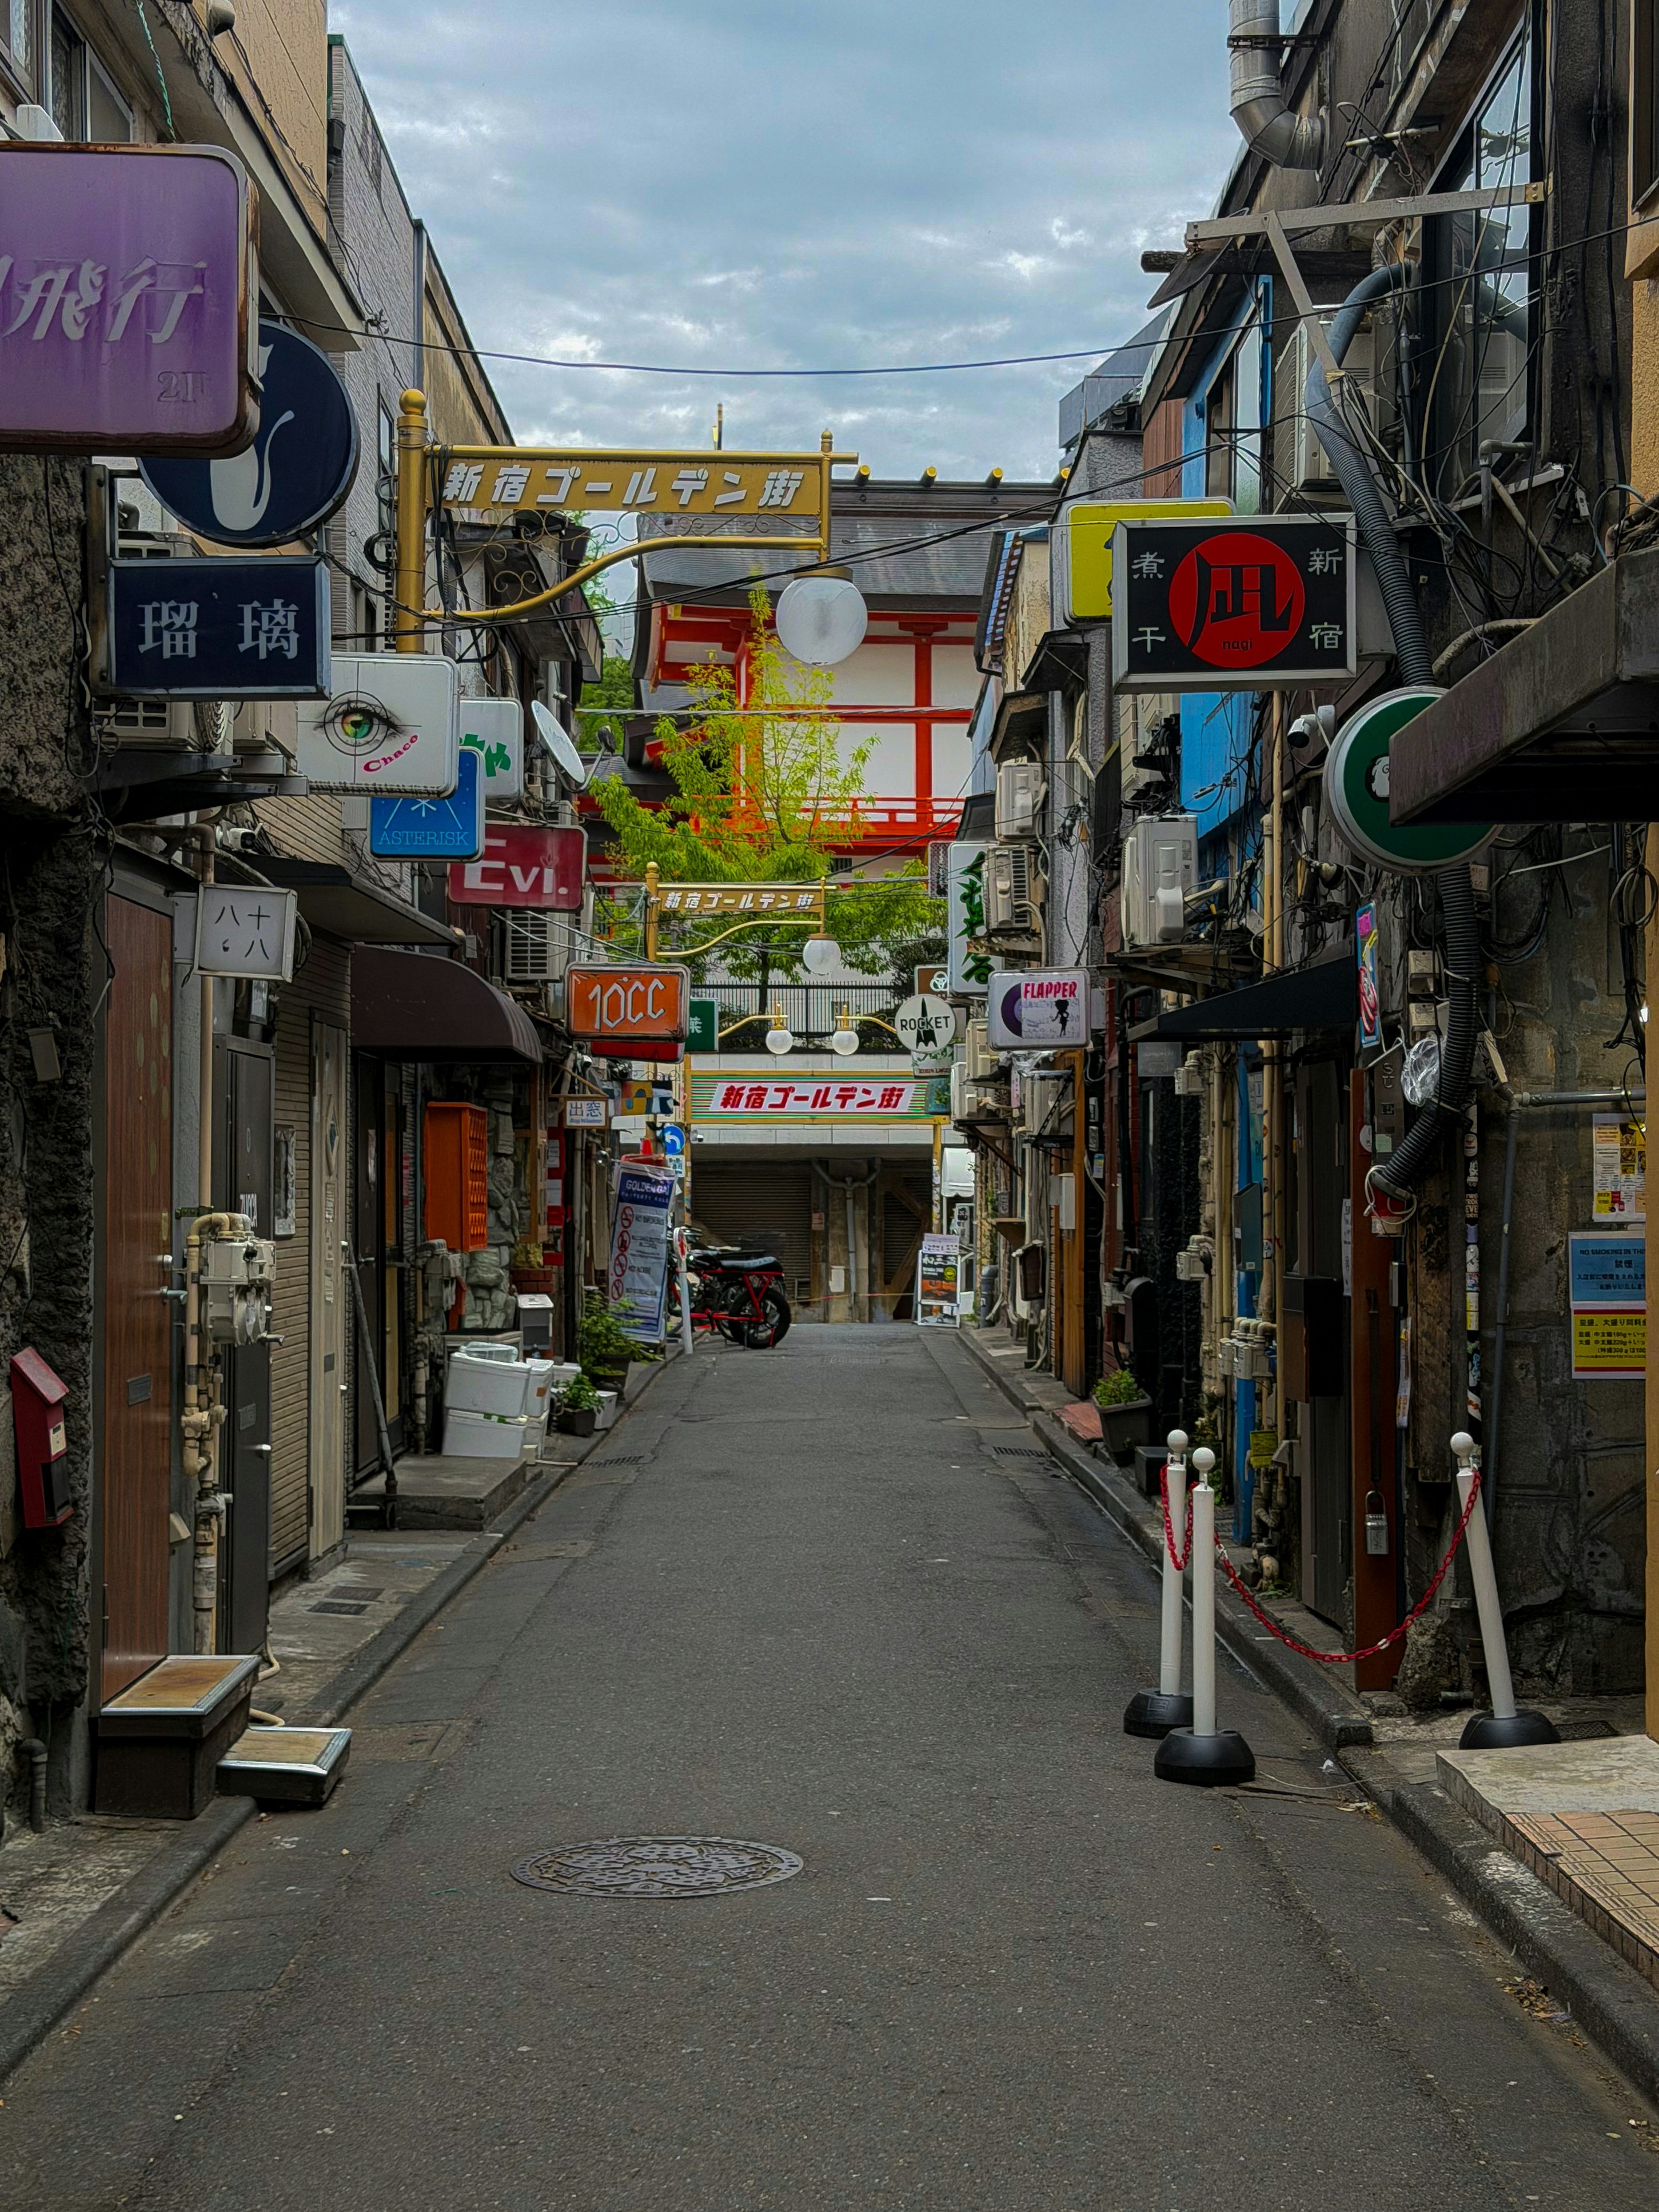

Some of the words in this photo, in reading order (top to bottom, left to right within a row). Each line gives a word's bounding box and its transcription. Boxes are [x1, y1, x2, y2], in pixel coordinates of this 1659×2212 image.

[442, 463, 804, 508] 新宿ゴールデン街
[137, 598, 300, 660] 瑠璃
[1222, 637, 1253, 652] nagi
[362, 734, 419, 773] Chaco
[378, 831, 470, 846] ASTERISK
[664, 892, 814, 910] 新宿ゴールデン街
[1023, 981, 1078, 1000] FLAPPER
[900, 1015, 951, 1031] ROCKET
[719, 1085, 906, 1109] 新宿ゴールデン街
[569, 1101, 603, 1117] 出窓
[625, 1179, 656, 1193] GOLDEN
